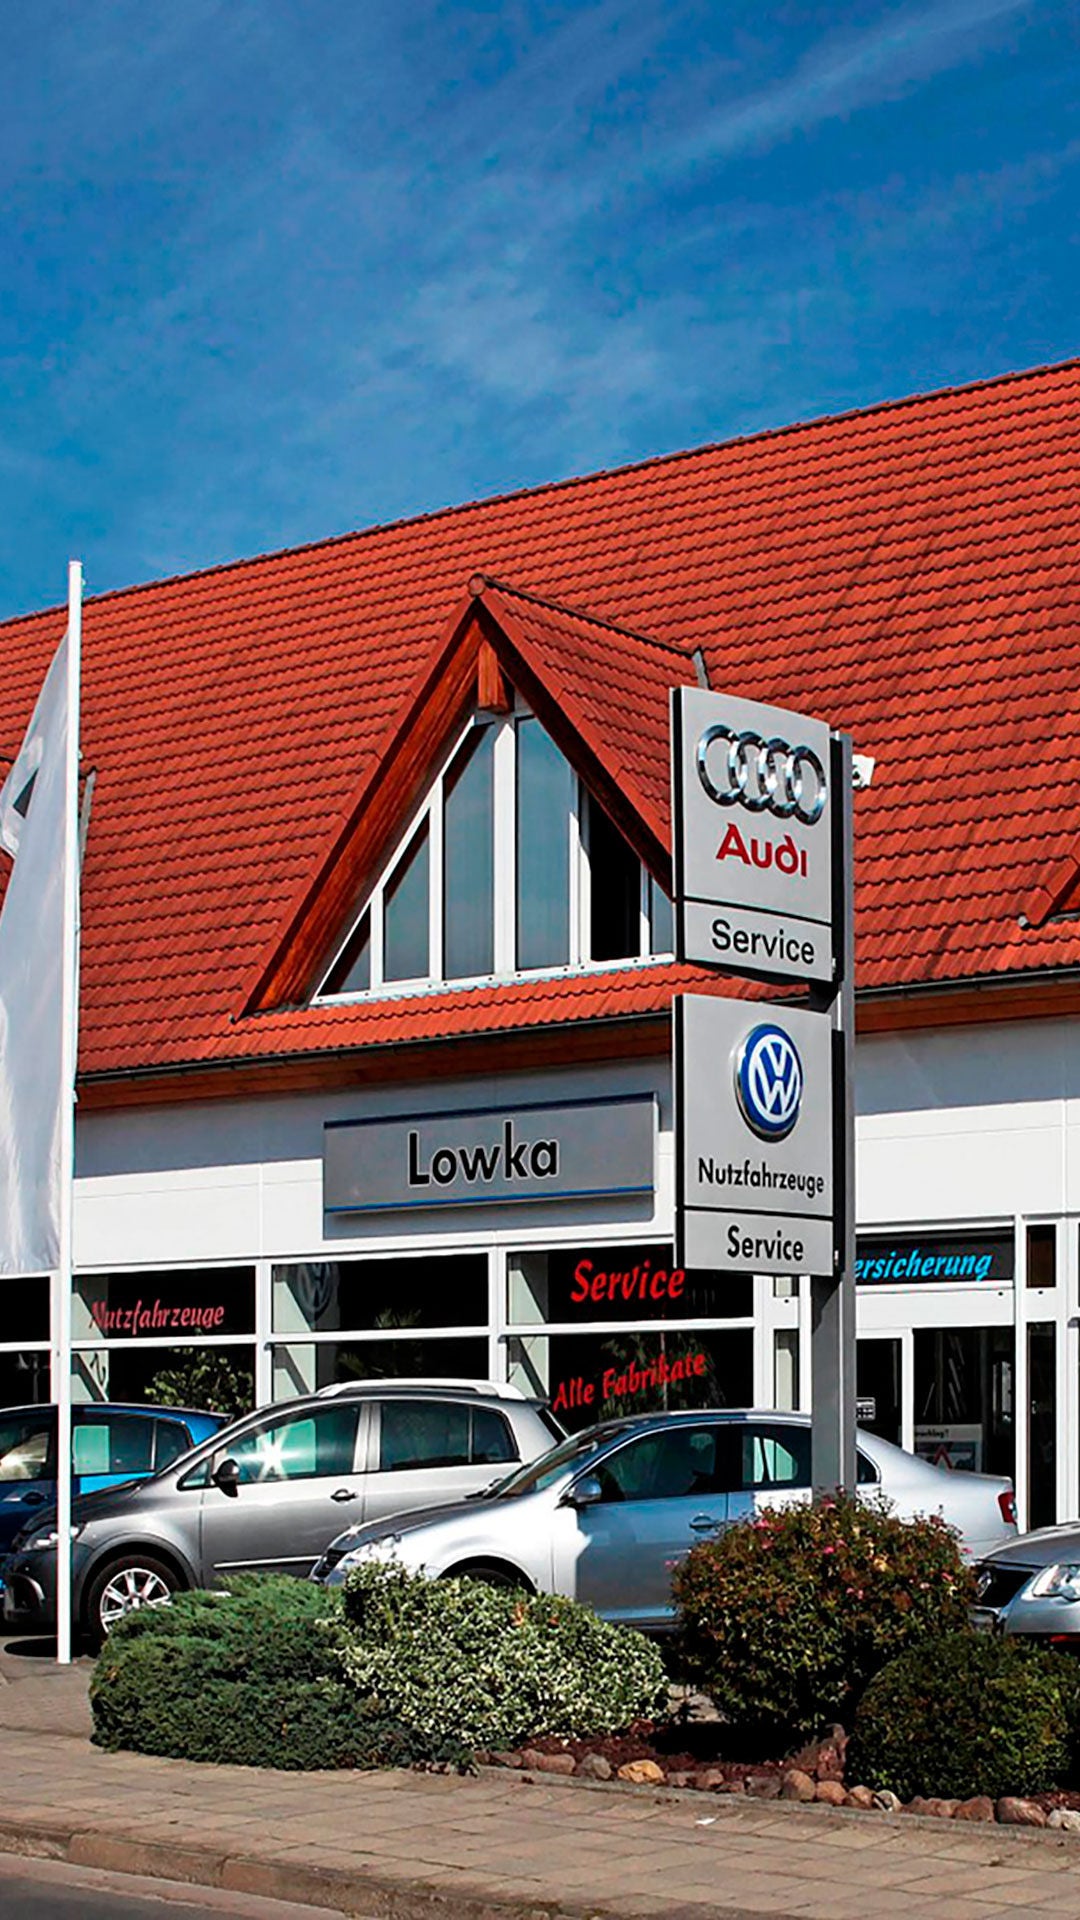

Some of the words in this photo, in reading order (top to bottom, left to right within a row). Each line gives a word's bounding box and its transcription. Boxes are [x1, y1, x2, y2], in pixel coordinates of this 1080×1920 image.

[716, 822, 808, 877] Audi
[711, 919, 815, 965] Service
[408, 1121, 557, 1186] Lowka
[698, 1157, 825, 1199] Nutzfahrzeuge
[726, 1224, 804, 1262] Service
[569, 1259, 686, 1303] Service
[854, 1249, 993, 1282] ersicherung
[89, 1299, 225, 1336] Nutzfahrzeuge
[552, 1376, 595, 1412] Alle
[602, 1353, 706, 1399] Fabrikate
